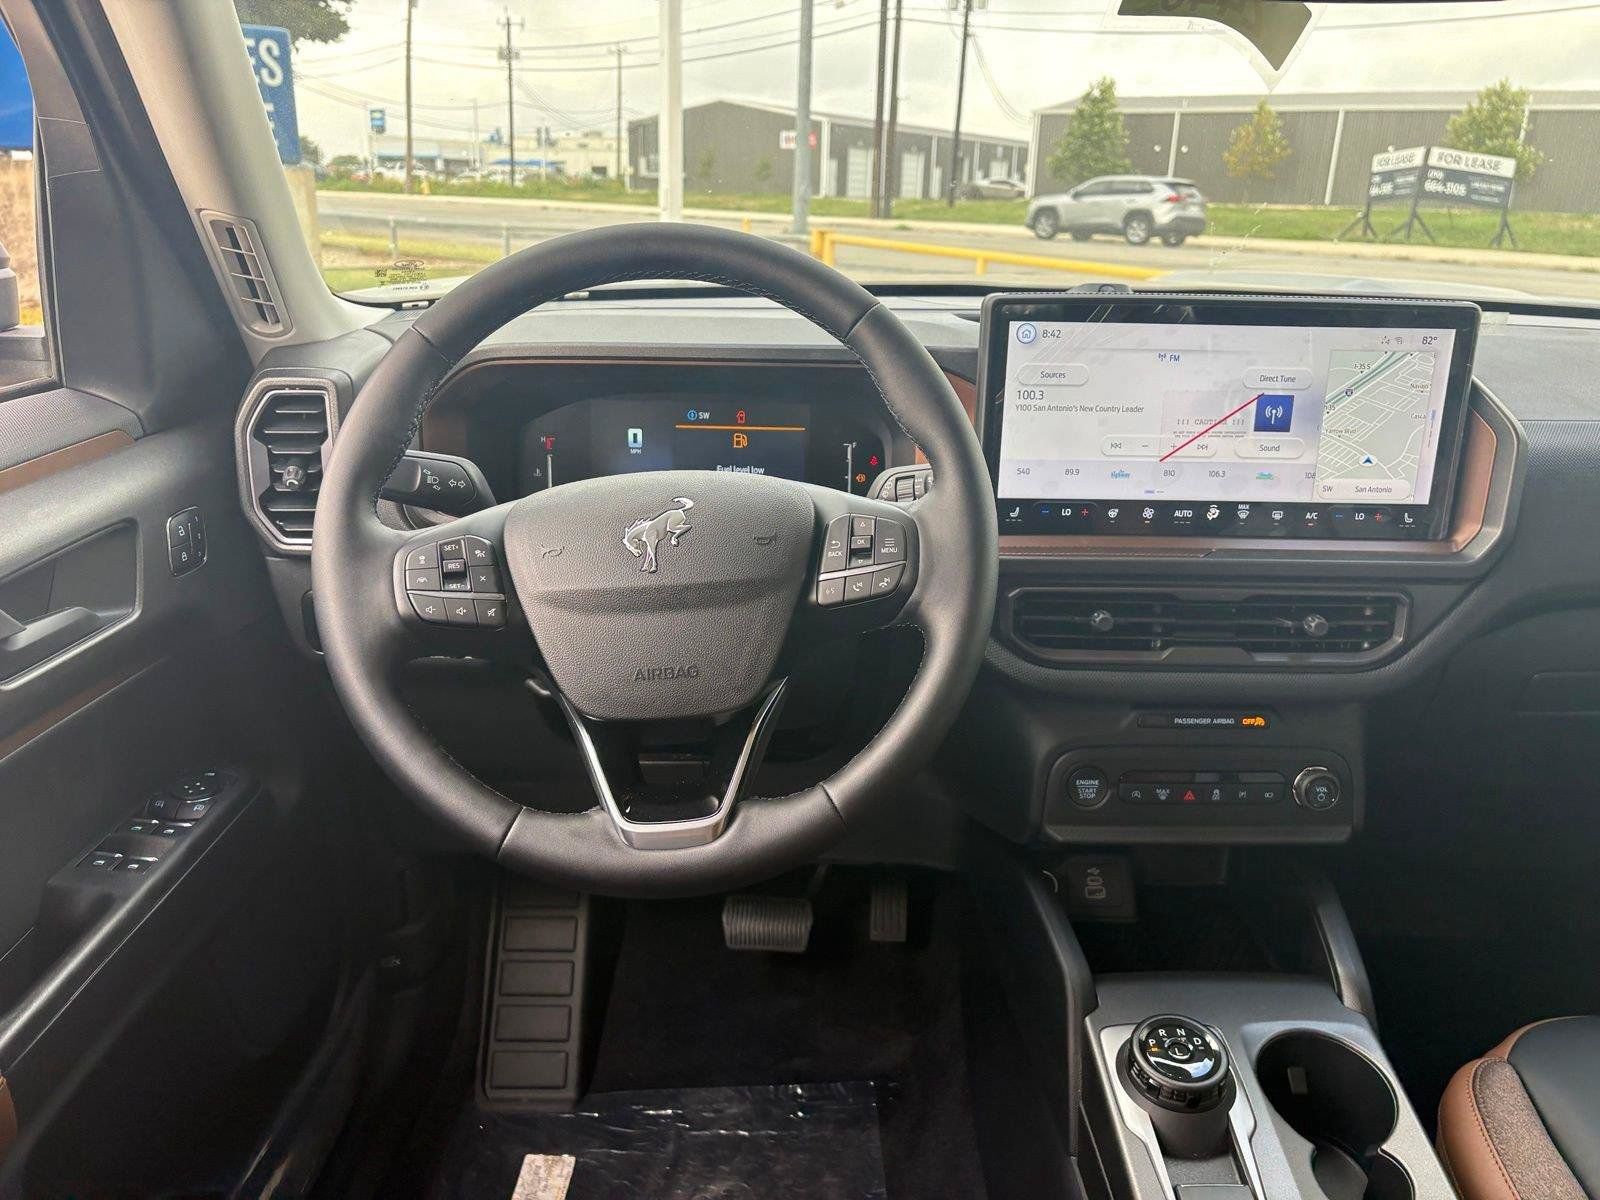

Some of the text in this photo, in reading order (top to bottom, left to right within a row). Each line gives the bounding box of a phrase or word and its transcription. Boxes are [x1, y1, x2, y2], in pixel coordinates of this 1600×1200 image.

[1437, 151, 1501, 171] FOR LEASE
[1042, 329, 1061, 339] 8:42
[1169, 354, 1180, 362] FM
[1040, 370, 1066, 379] Sources
[1259, 374, 1296, 383] Direct Tune
[1016, 389, 1044, 400] 100.3
[1015, 404, 1144, 414] Y100 San Antonio's New Country Leader
[699, 411, 710, 420] SW
[628, 428, 643, 448] 0
[1259, 443, 1280, 452] Sound
[733, 465, 750, 473] level
[751, 465, 765, 474] low
[1016, 468, 1030, 476] 540
[1065, 468, 1080, 476] 89.9
[1163, 469, 1176, 477] 810
[1208, 470, 1226, 478] 106.3
[1322, 485, 1333, 493] SW
[1355, 485, 1392, 493] San Antonio
[1061, 508, 1072, 516] LO
[1174, 510, 1193, 518] AUTO
[1305, 512, 1318, 520] A/C
[634, 665, 699, 681] AIRBAG
[1174, 717, 1211, 725] PASSENGER
[1212, 717, 1235, 725] AIRBAG
[1177, 1028, 1186, 1036] N
[1175, 1047, 1182, 1055] L
